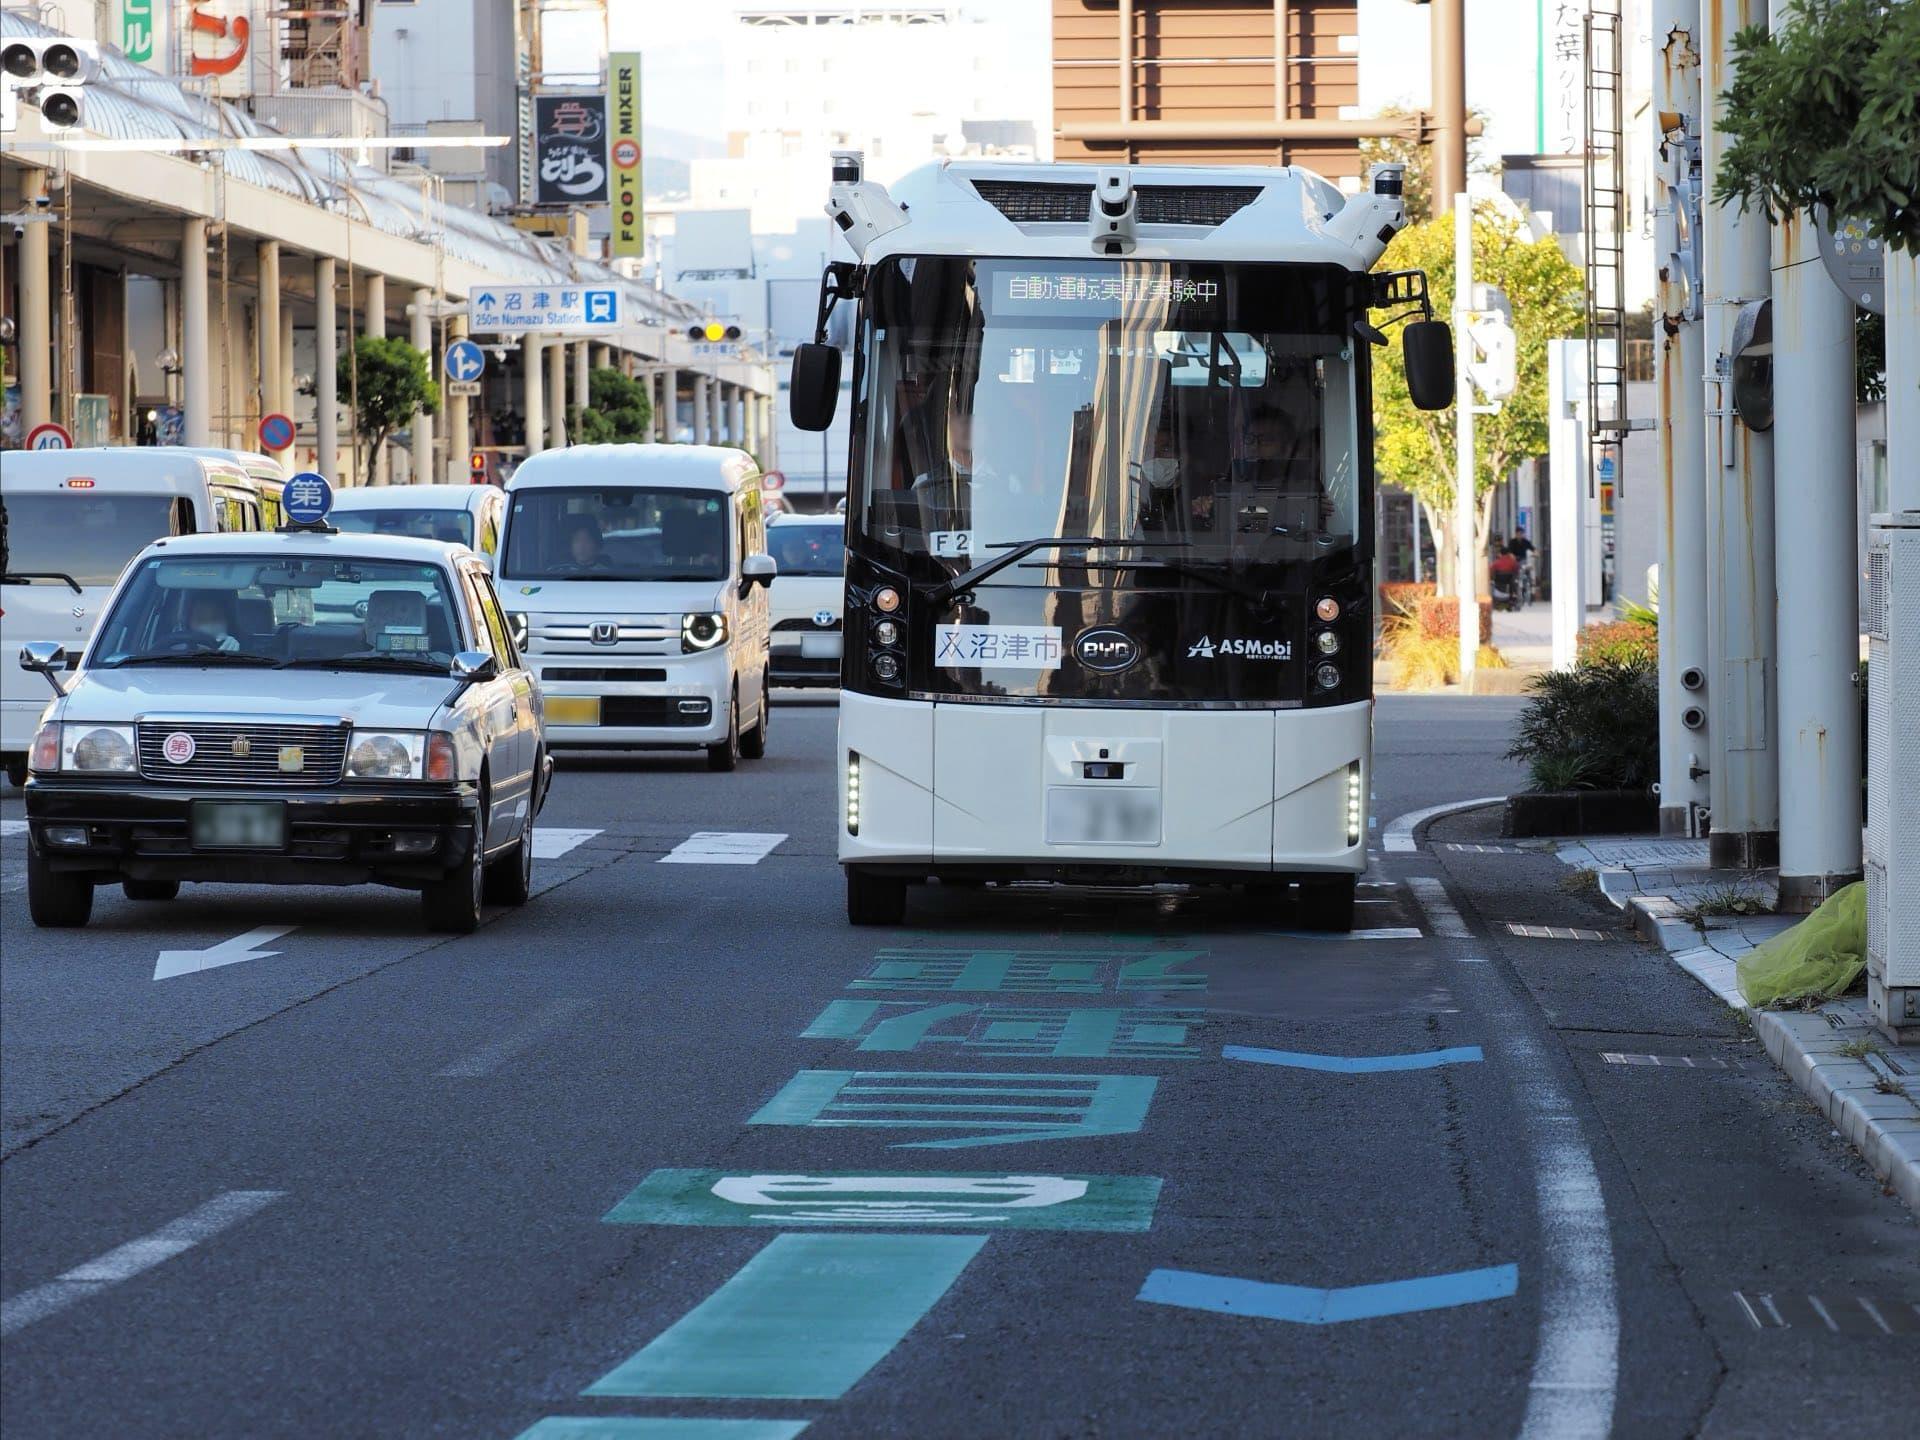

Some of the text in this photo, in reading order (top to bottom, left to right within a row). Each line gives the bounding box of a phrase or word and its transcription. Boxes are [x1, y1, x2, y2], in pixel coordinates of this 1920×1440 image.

[619, 68, 632, 134] MIXER
[620, 174, 634, 241] FOOT
[504, 291, 579, 310] 沼津駅
[1009, 276, 1218, 302] 自動運転実証実験中
[476, 311, 582, 326] 250m Numazu Station
[290, 479, 323, 514] 第一
[970, 633, 1060, 661] 沼津市
[1084, 641, 1130, 657] BYD
[1219, 638, 1292, 656] ASMobi
